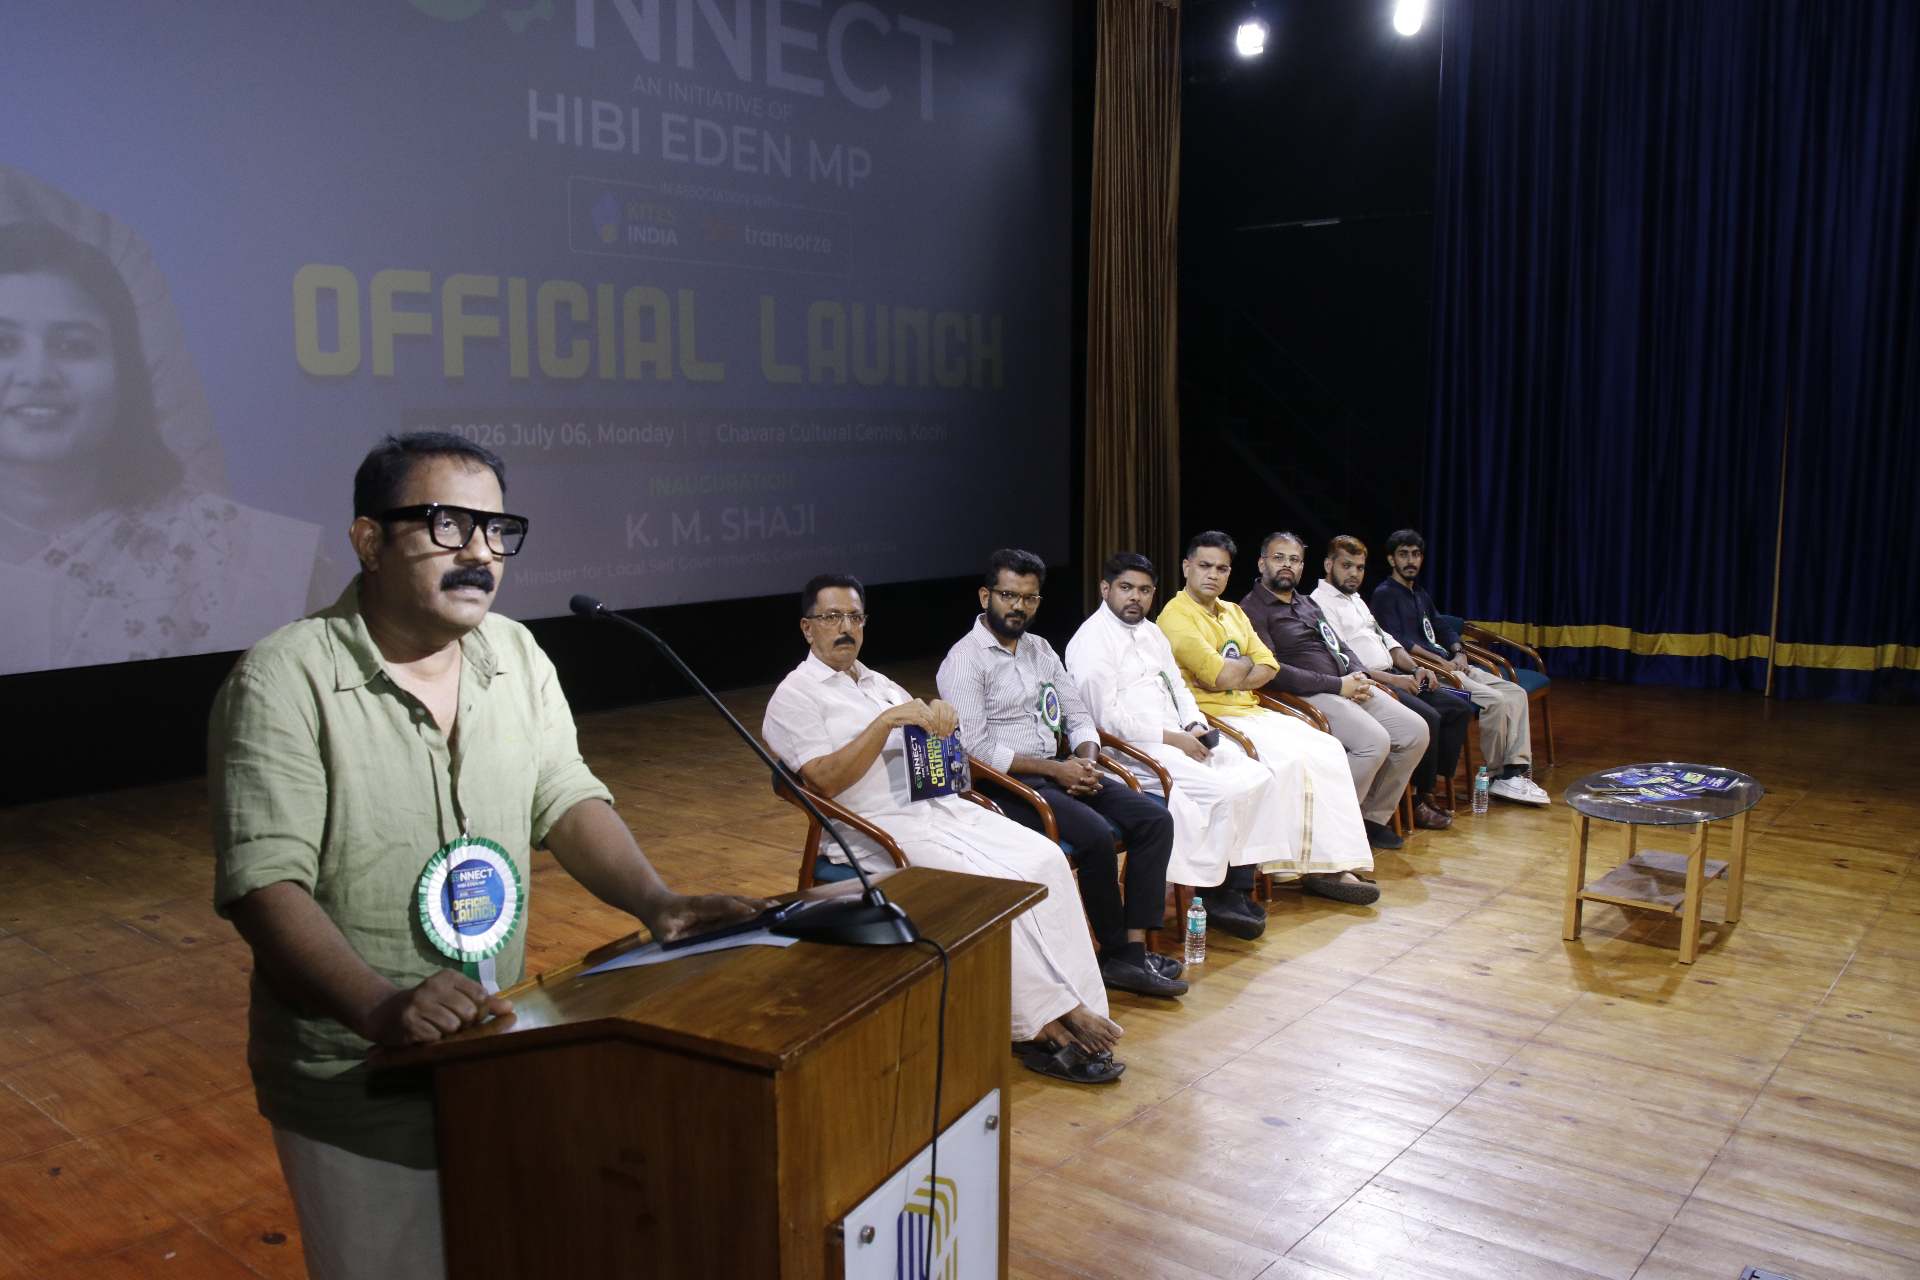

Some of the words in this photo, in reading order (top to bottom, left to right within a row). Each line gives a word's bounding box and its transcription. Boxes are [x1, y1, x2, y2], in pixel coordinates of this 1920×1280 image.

[631, 75, 662, 97] AN
[667, 80, 763, 118] INITIATIVE
[769, 102, 794, 124] OF
[528, 88, 641, 154] HIBI
[661, 112, 793, 179] EDEN
[809, 143, 873, 189] MP
[627, 202, 676, 223] KITES
[628, 225, 679, 246] INDIA
[744, 224, 832, 253] transorze
[293, 263, 725, 382] OFFICIAL
[760, 295, 1003, 389] LAUNCH
[512, 423, 555, 449] July
[561, 424, 592, 448] 06,
[598, 423, 674, 447] Monday
[716, 423, 785, 443] Chavara
[789, 423, 851, 442] Cultural
[855, 423, 907, 443] Centre,
[910, 423, 948, 441] Kochi
[650, 472, 796, 496] INAUGURATION
[625, 512, 659, 549] K.
[671, 510, 711, 546] M.
[721, 503, 816, 542] SHAJI
[514, 568, 576, 585] Minister
[583, 564, 602, 580] for
[608, 560, 645, 577] Local
[649, 557, 675, 573] Self
[926, 735, 938, 785] OFFICIAL
[451, 905, 496, 923] LAUNCH
[453, 895, 493, 911] OFFICIAL
